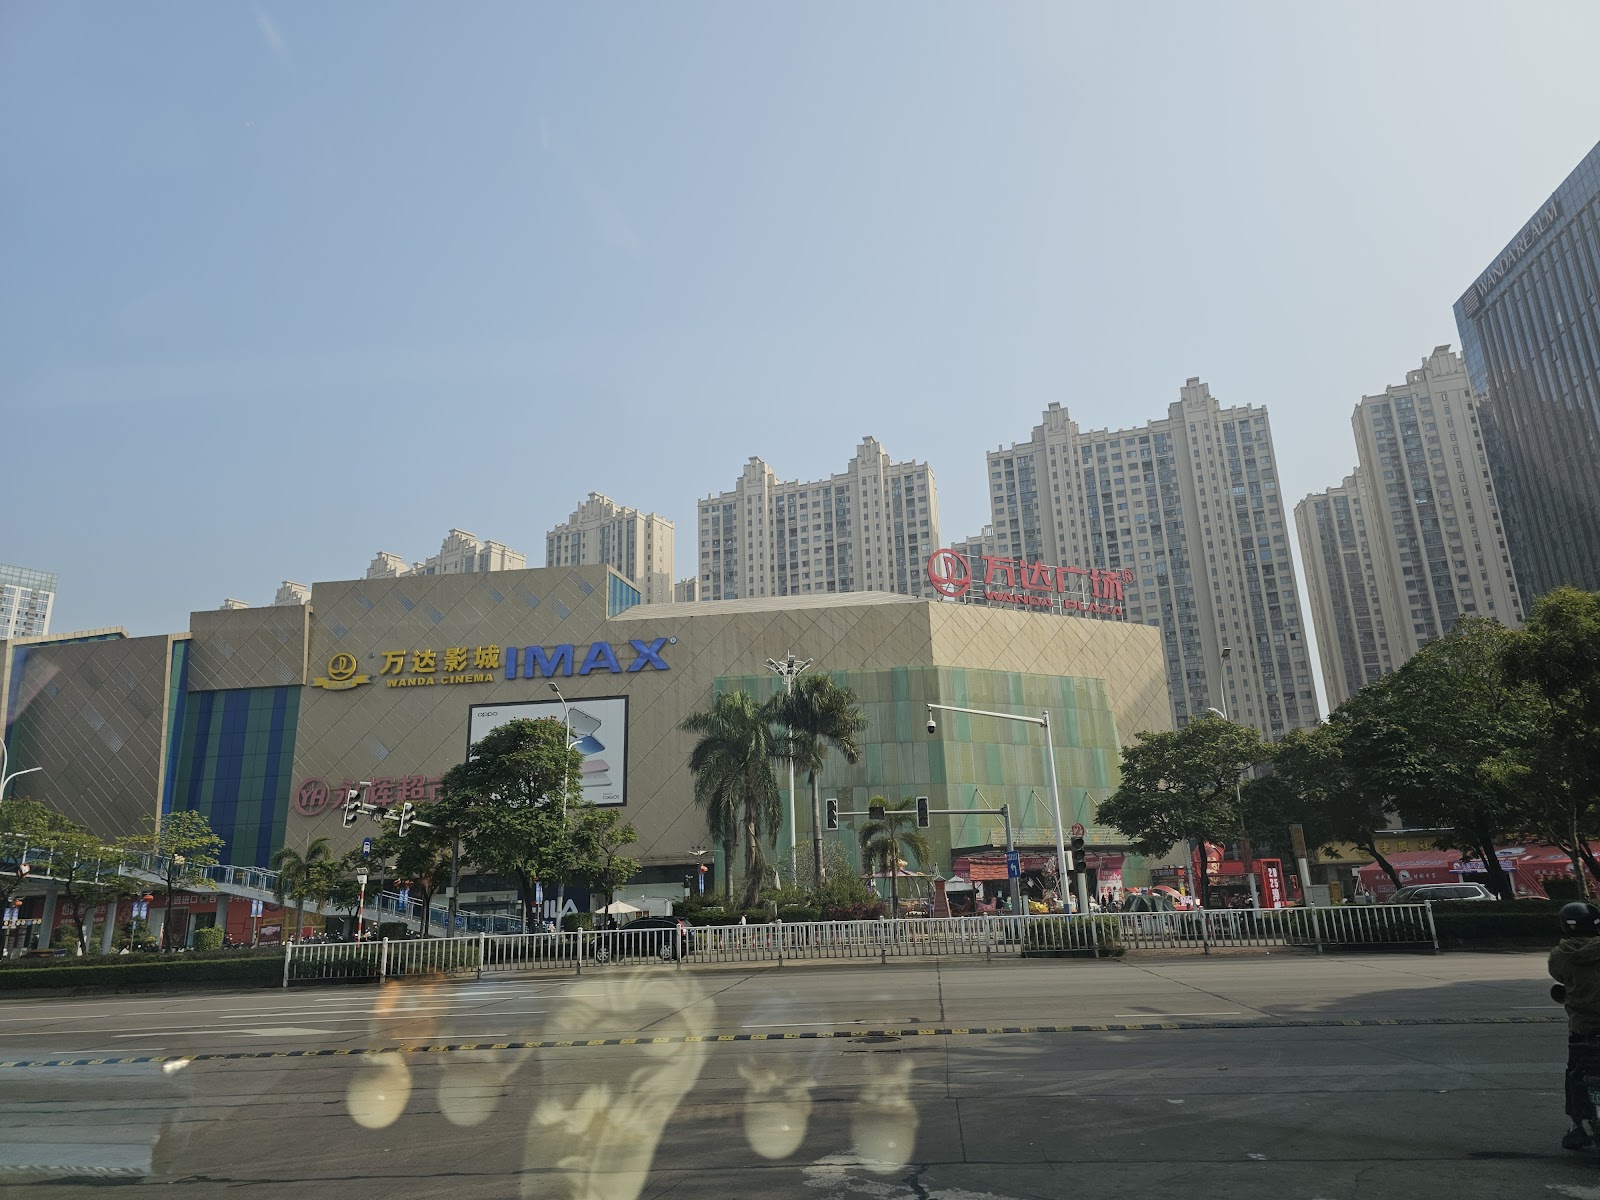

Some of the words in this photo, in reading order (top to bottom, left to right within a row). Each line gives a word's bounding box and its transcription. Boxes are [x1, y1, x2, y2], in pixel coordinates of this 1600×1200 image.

[1475, 250, 1517, 297] WANDA
[1515, 200, 1558, 258] REALM
[981, 555, 1123, 600] 万达广场
[983, 590, 1053, 607] WANDA
[1064, 599, 1124, 616] PLAZA
[380, 644, 500, 675] 万达影城
[505, 637, 670, 680] IMAX
[386, 676, 435, 688] WANDA
[440, 673, 494, 685] CINEMA
